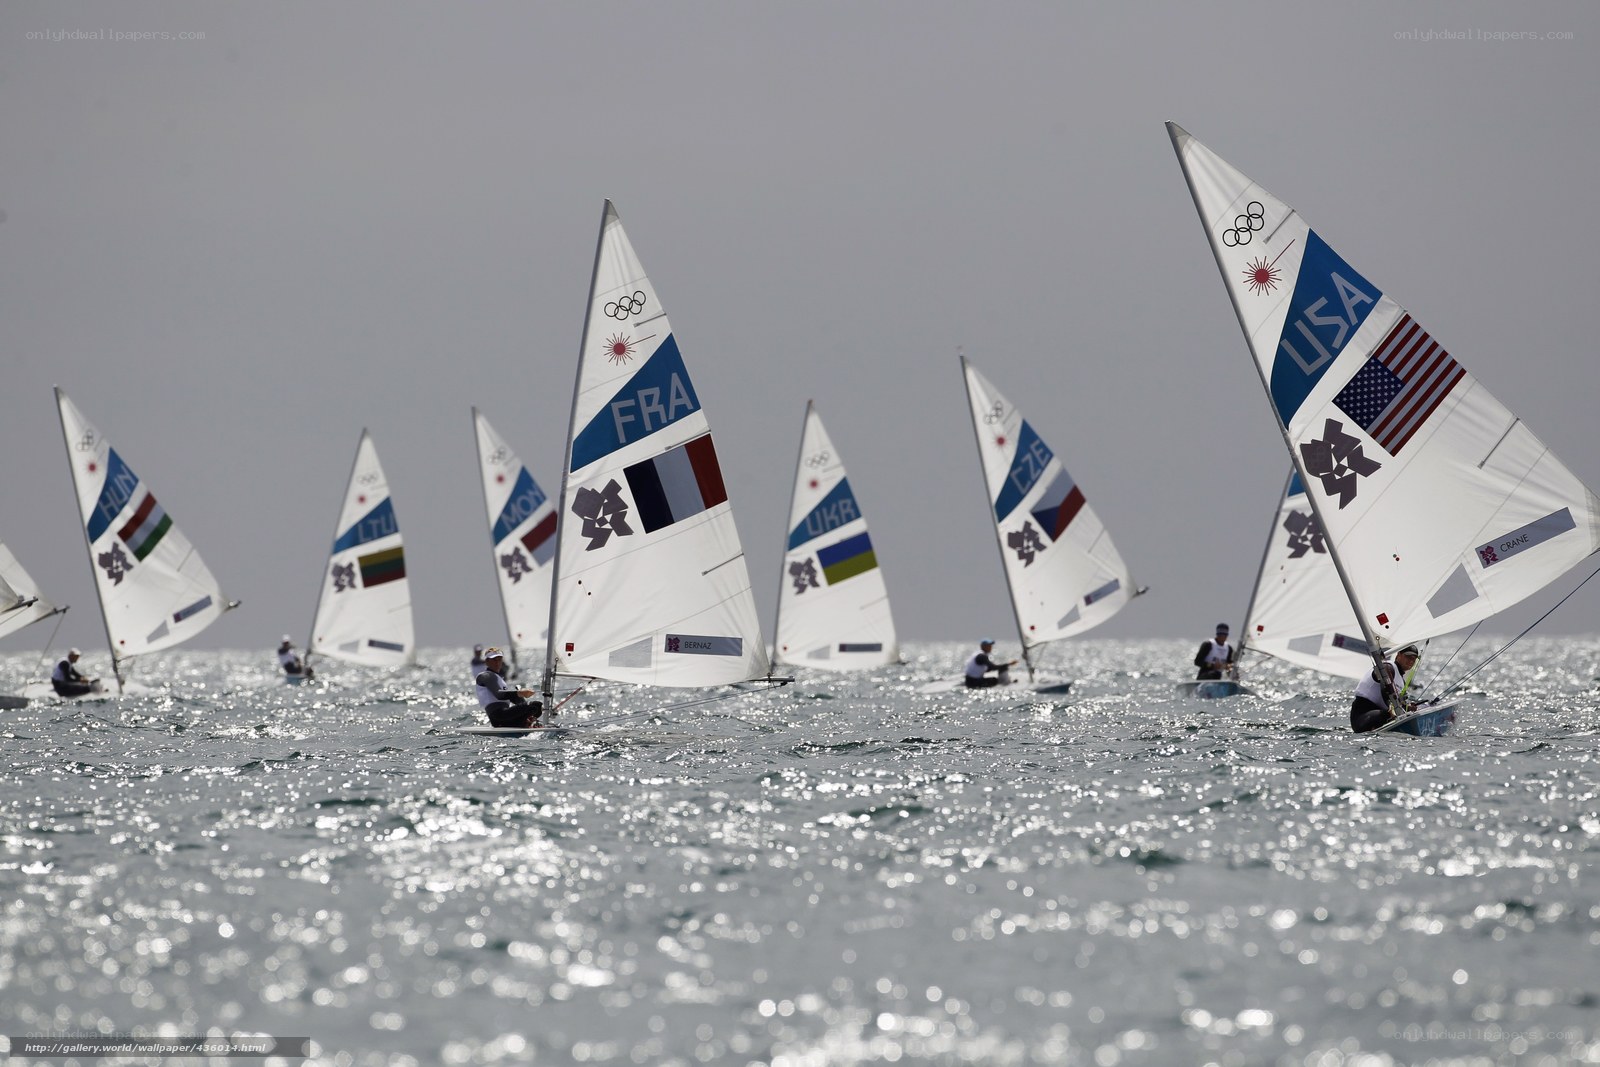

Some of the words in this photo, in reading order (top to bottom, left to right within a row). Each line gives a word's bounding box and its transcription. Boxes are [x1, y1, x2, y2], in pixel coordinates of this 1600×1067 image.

[1279, 271, 1374, 376] USA
[611, 372, 693, 444] FRA
[1010, 439, 1050, 495] CZE
[98, 464, 137, 522] HUN
[358, 512, 395, 543] LTU
[806, 499, 855, 537] UKR
[1500, 533, 1530, 553] CRANE
[684, 641, 712, 650] BERNAZ
